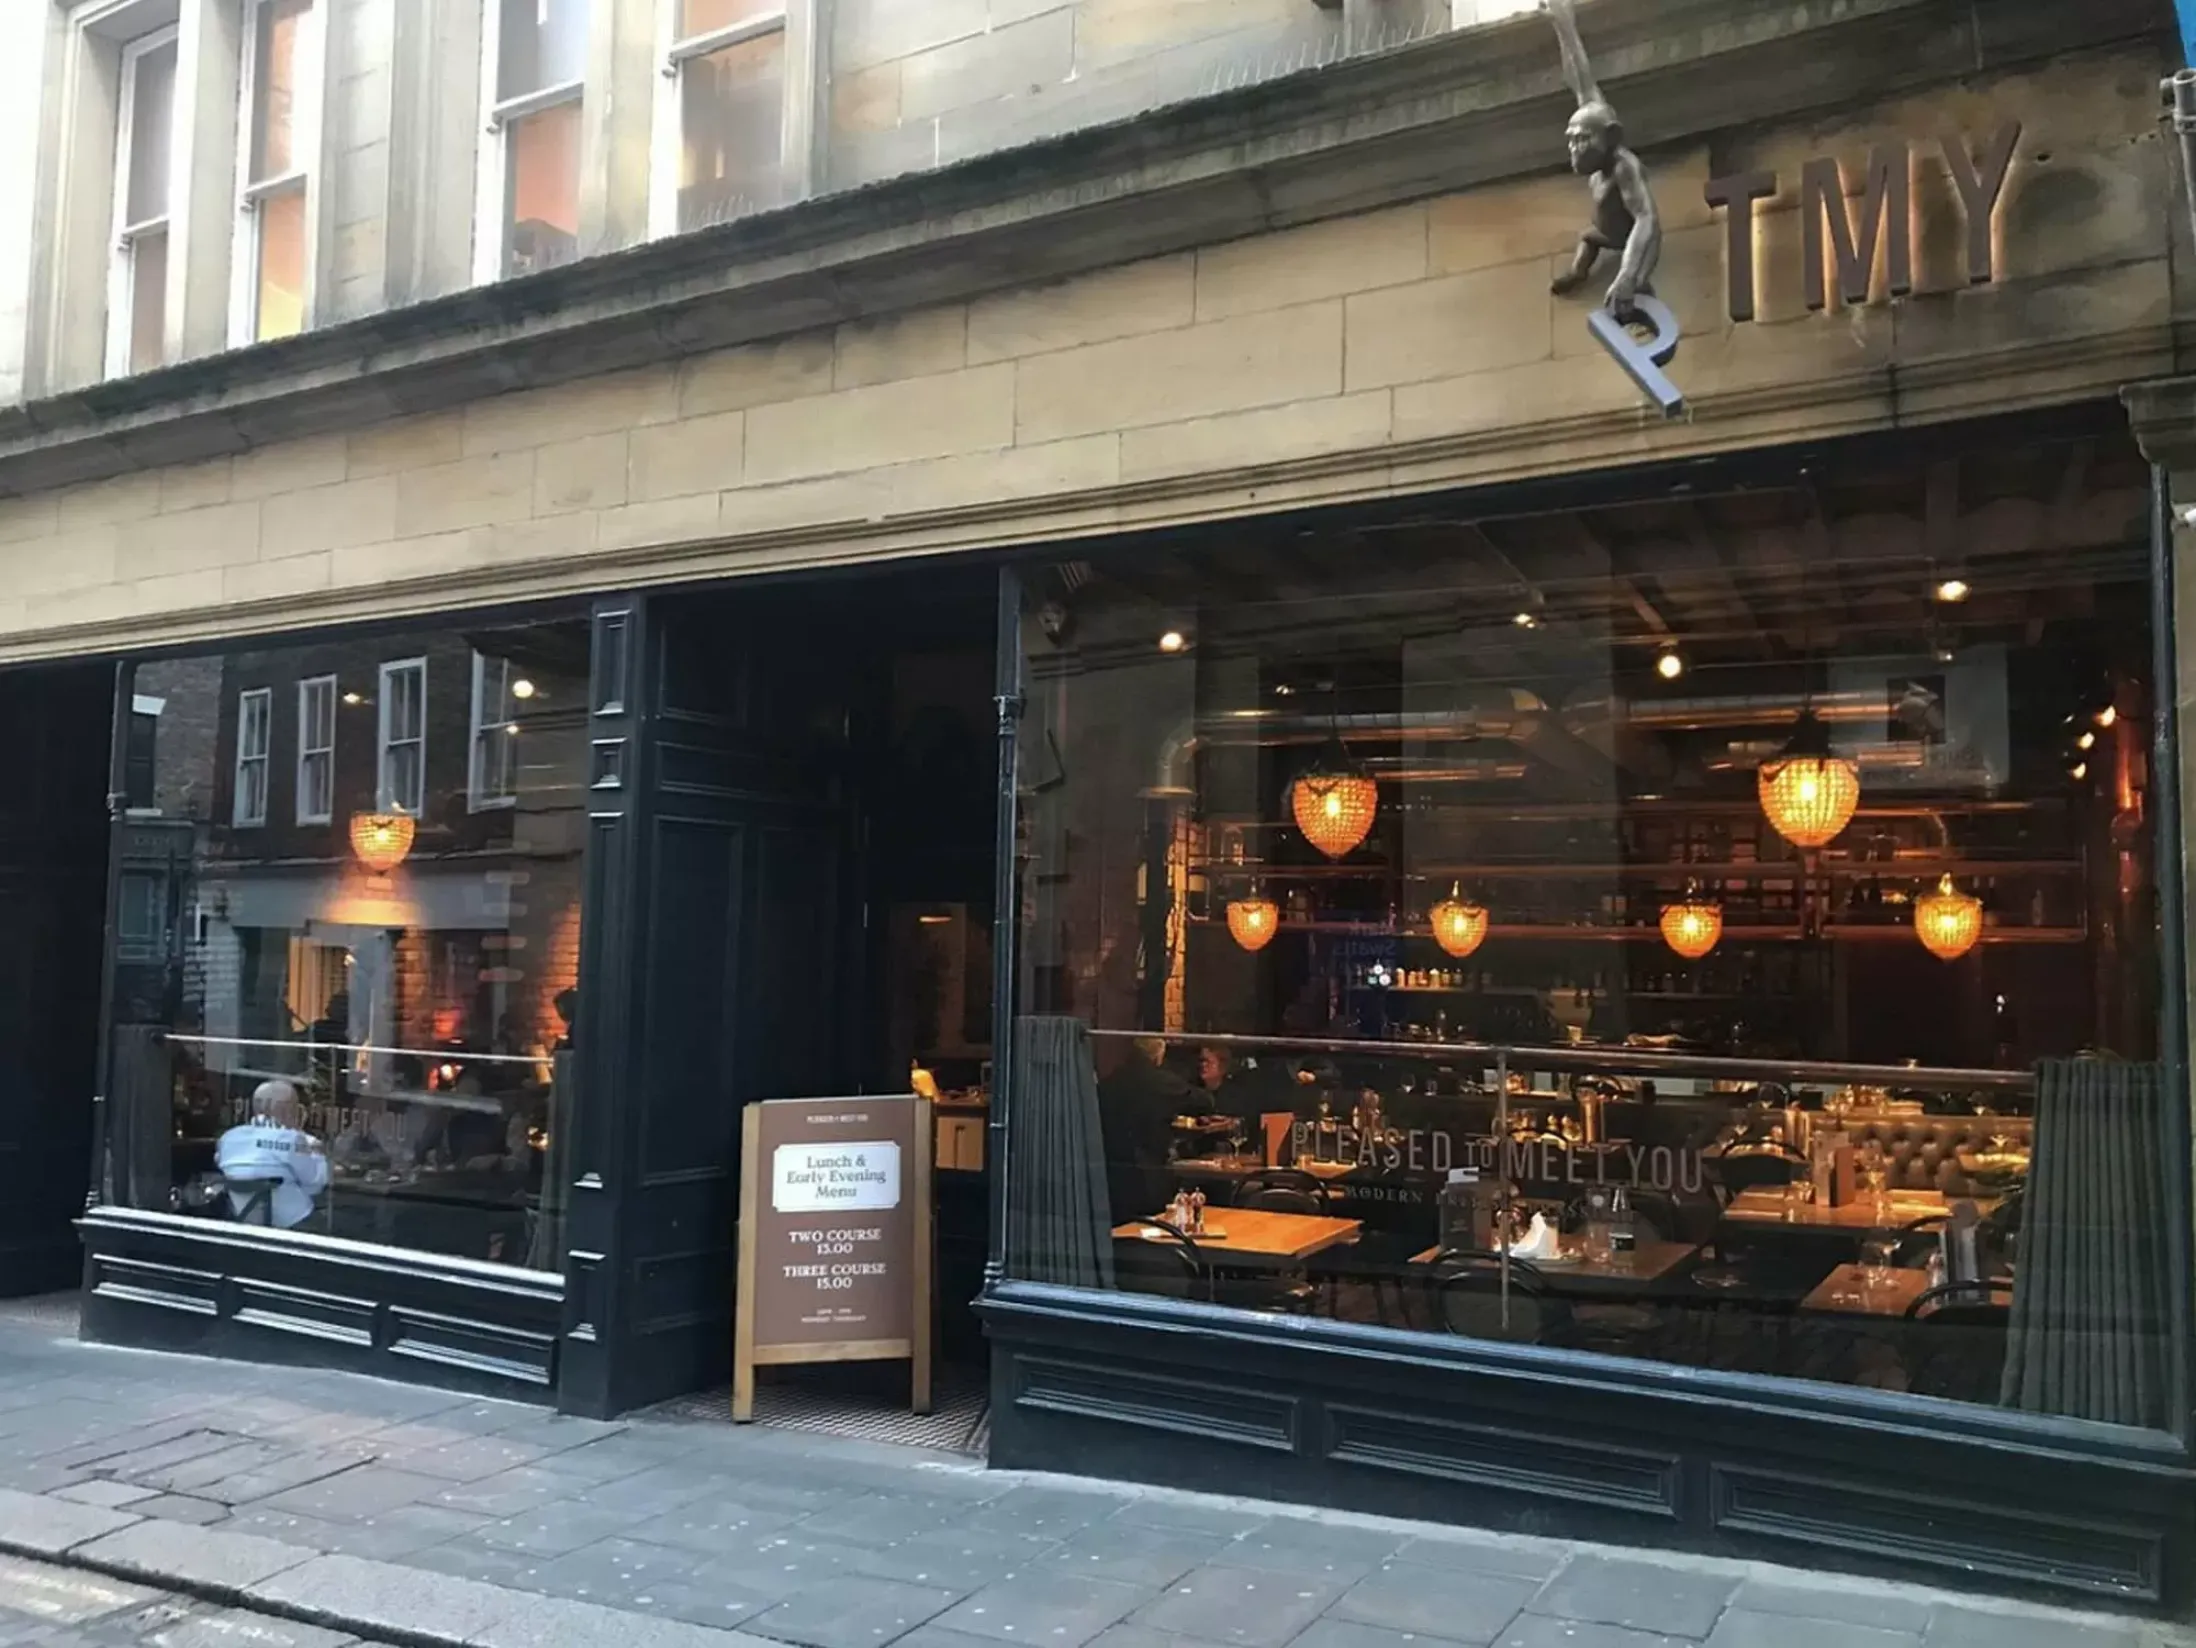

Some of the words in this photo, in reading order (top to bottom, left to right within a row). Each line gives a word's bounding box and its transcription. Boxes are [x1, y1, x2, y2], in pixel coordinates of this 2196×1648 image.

[1587, 293, 1683, 418] P
[1703, 120, 2022, 323] TMY
[807, 1155, 852, 1169] Lunch
[855, 1154, 867, 1168] &
[1291, 1121, 1452, 1173] PLEASED
[1464, 1139, 1493, 1169] TO
[1506, 1135, 1612, 1186] MEET
[1624, 1144, 1703, 1194] YOU
[787, 1170, 826, 1184] Early
[830, 1169, 887, 1184] Evening
[815, 1185, 857, 1199] Menu
[1345, 1185, 1424, 1204] MODERN
[788, 1229, 824, 1243] TWO
[826, 1228, 882, 1241] COURSE
[783, 1264, 828, 1278] THREE
[831, 1262, 887, 1275] COURSE
